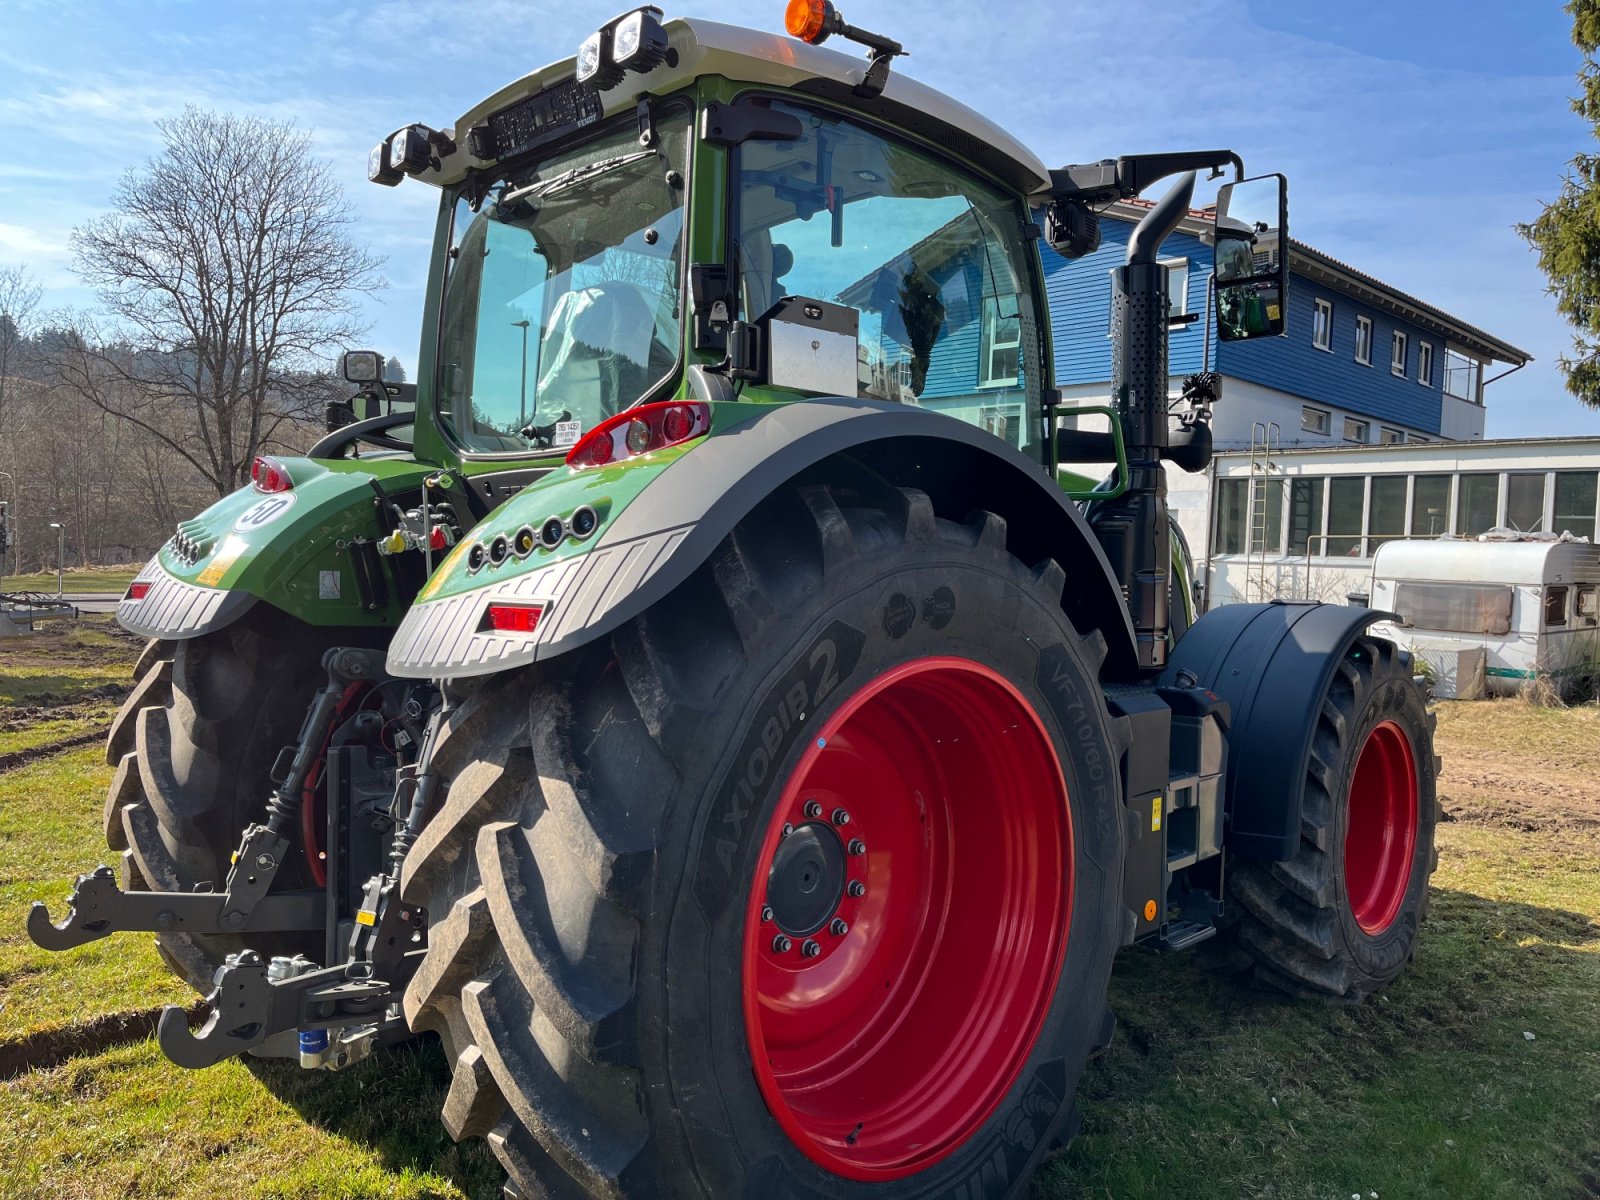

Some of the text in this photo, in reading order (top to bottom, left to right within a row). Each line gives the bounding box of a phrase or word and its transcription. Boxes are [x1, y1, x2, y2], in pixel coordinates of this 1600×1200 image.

[241, 498, 288, 525] 50
[715, 638, 840, 877] AXIOBIB 2
